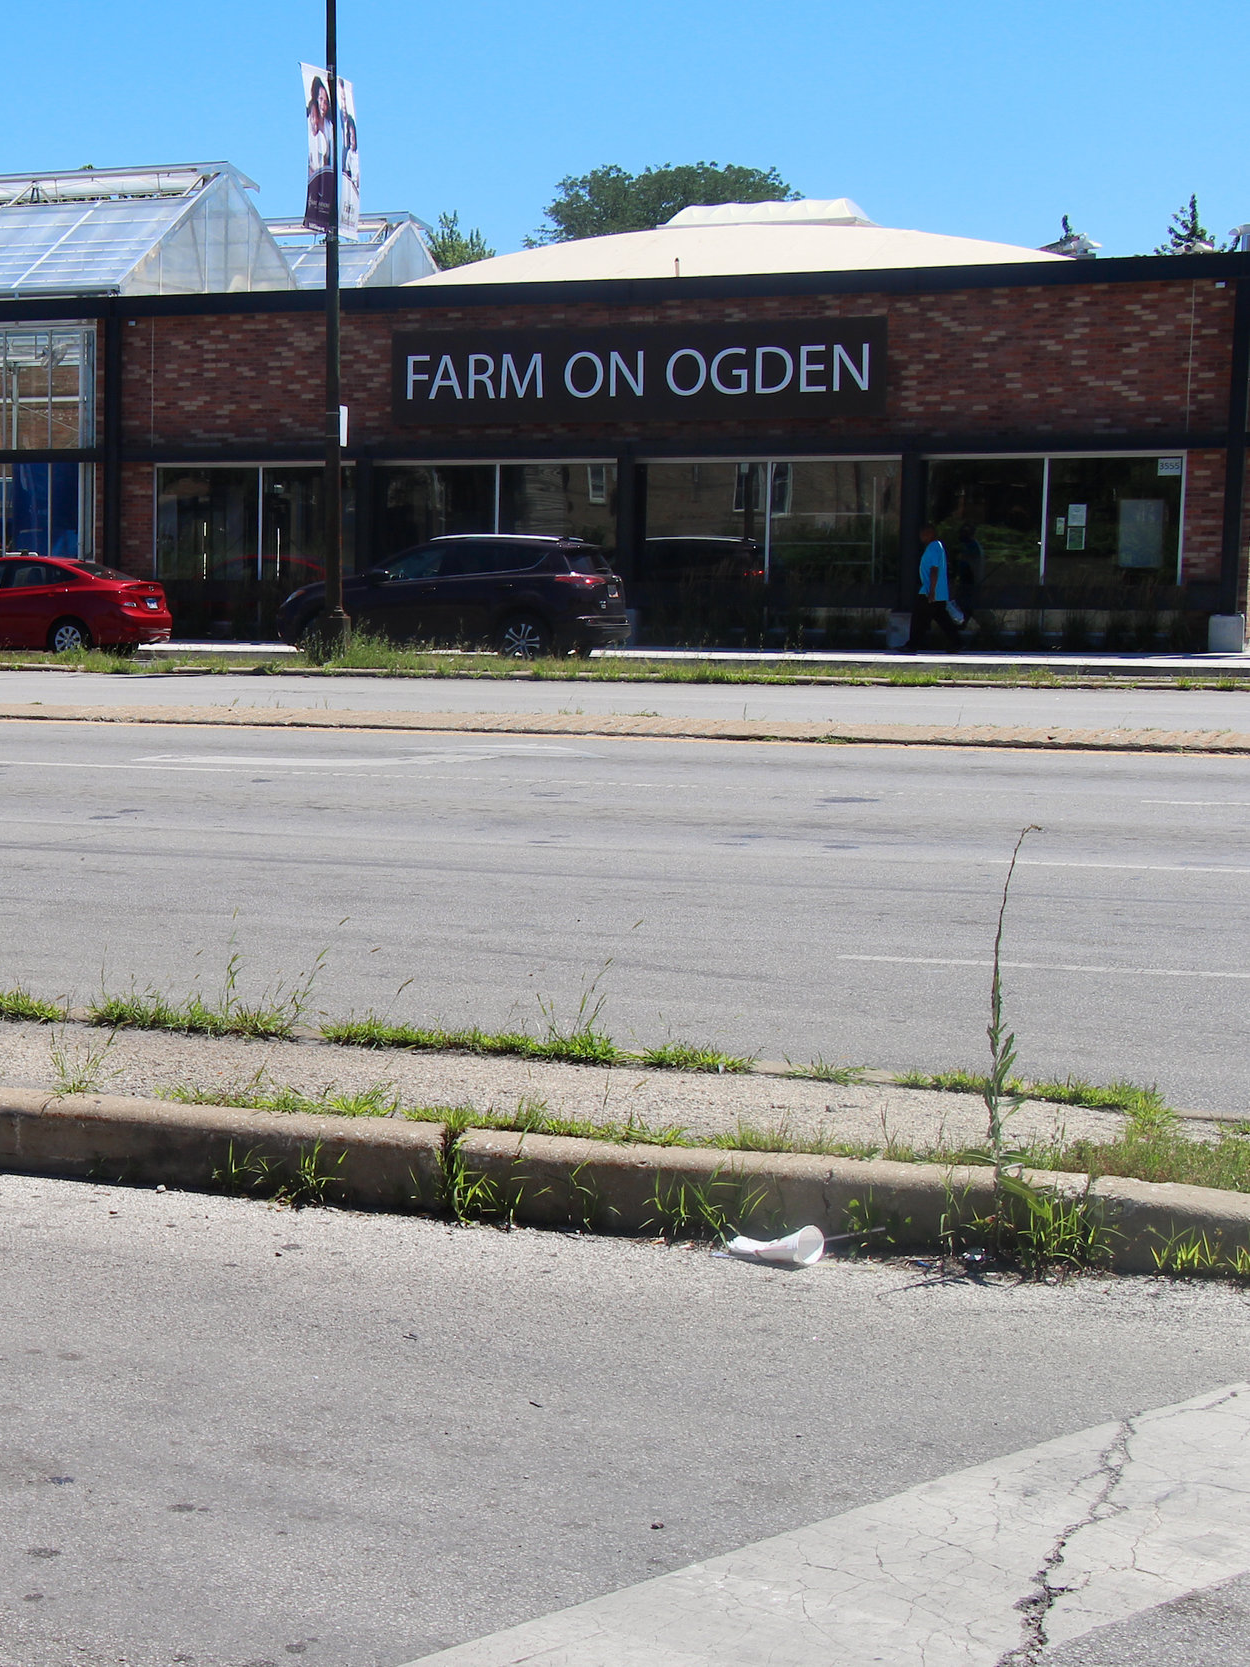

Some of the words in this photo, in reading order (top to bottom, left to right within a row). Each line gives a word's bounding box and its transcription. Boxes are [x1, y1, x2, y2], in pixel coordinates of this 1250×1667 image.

[406, 353, 543, 400] FARM
[564, 350, 644, 399] ON
[665, 344, 870, 396] OGDEN
[1159, 462, 1180, 471] 3555
